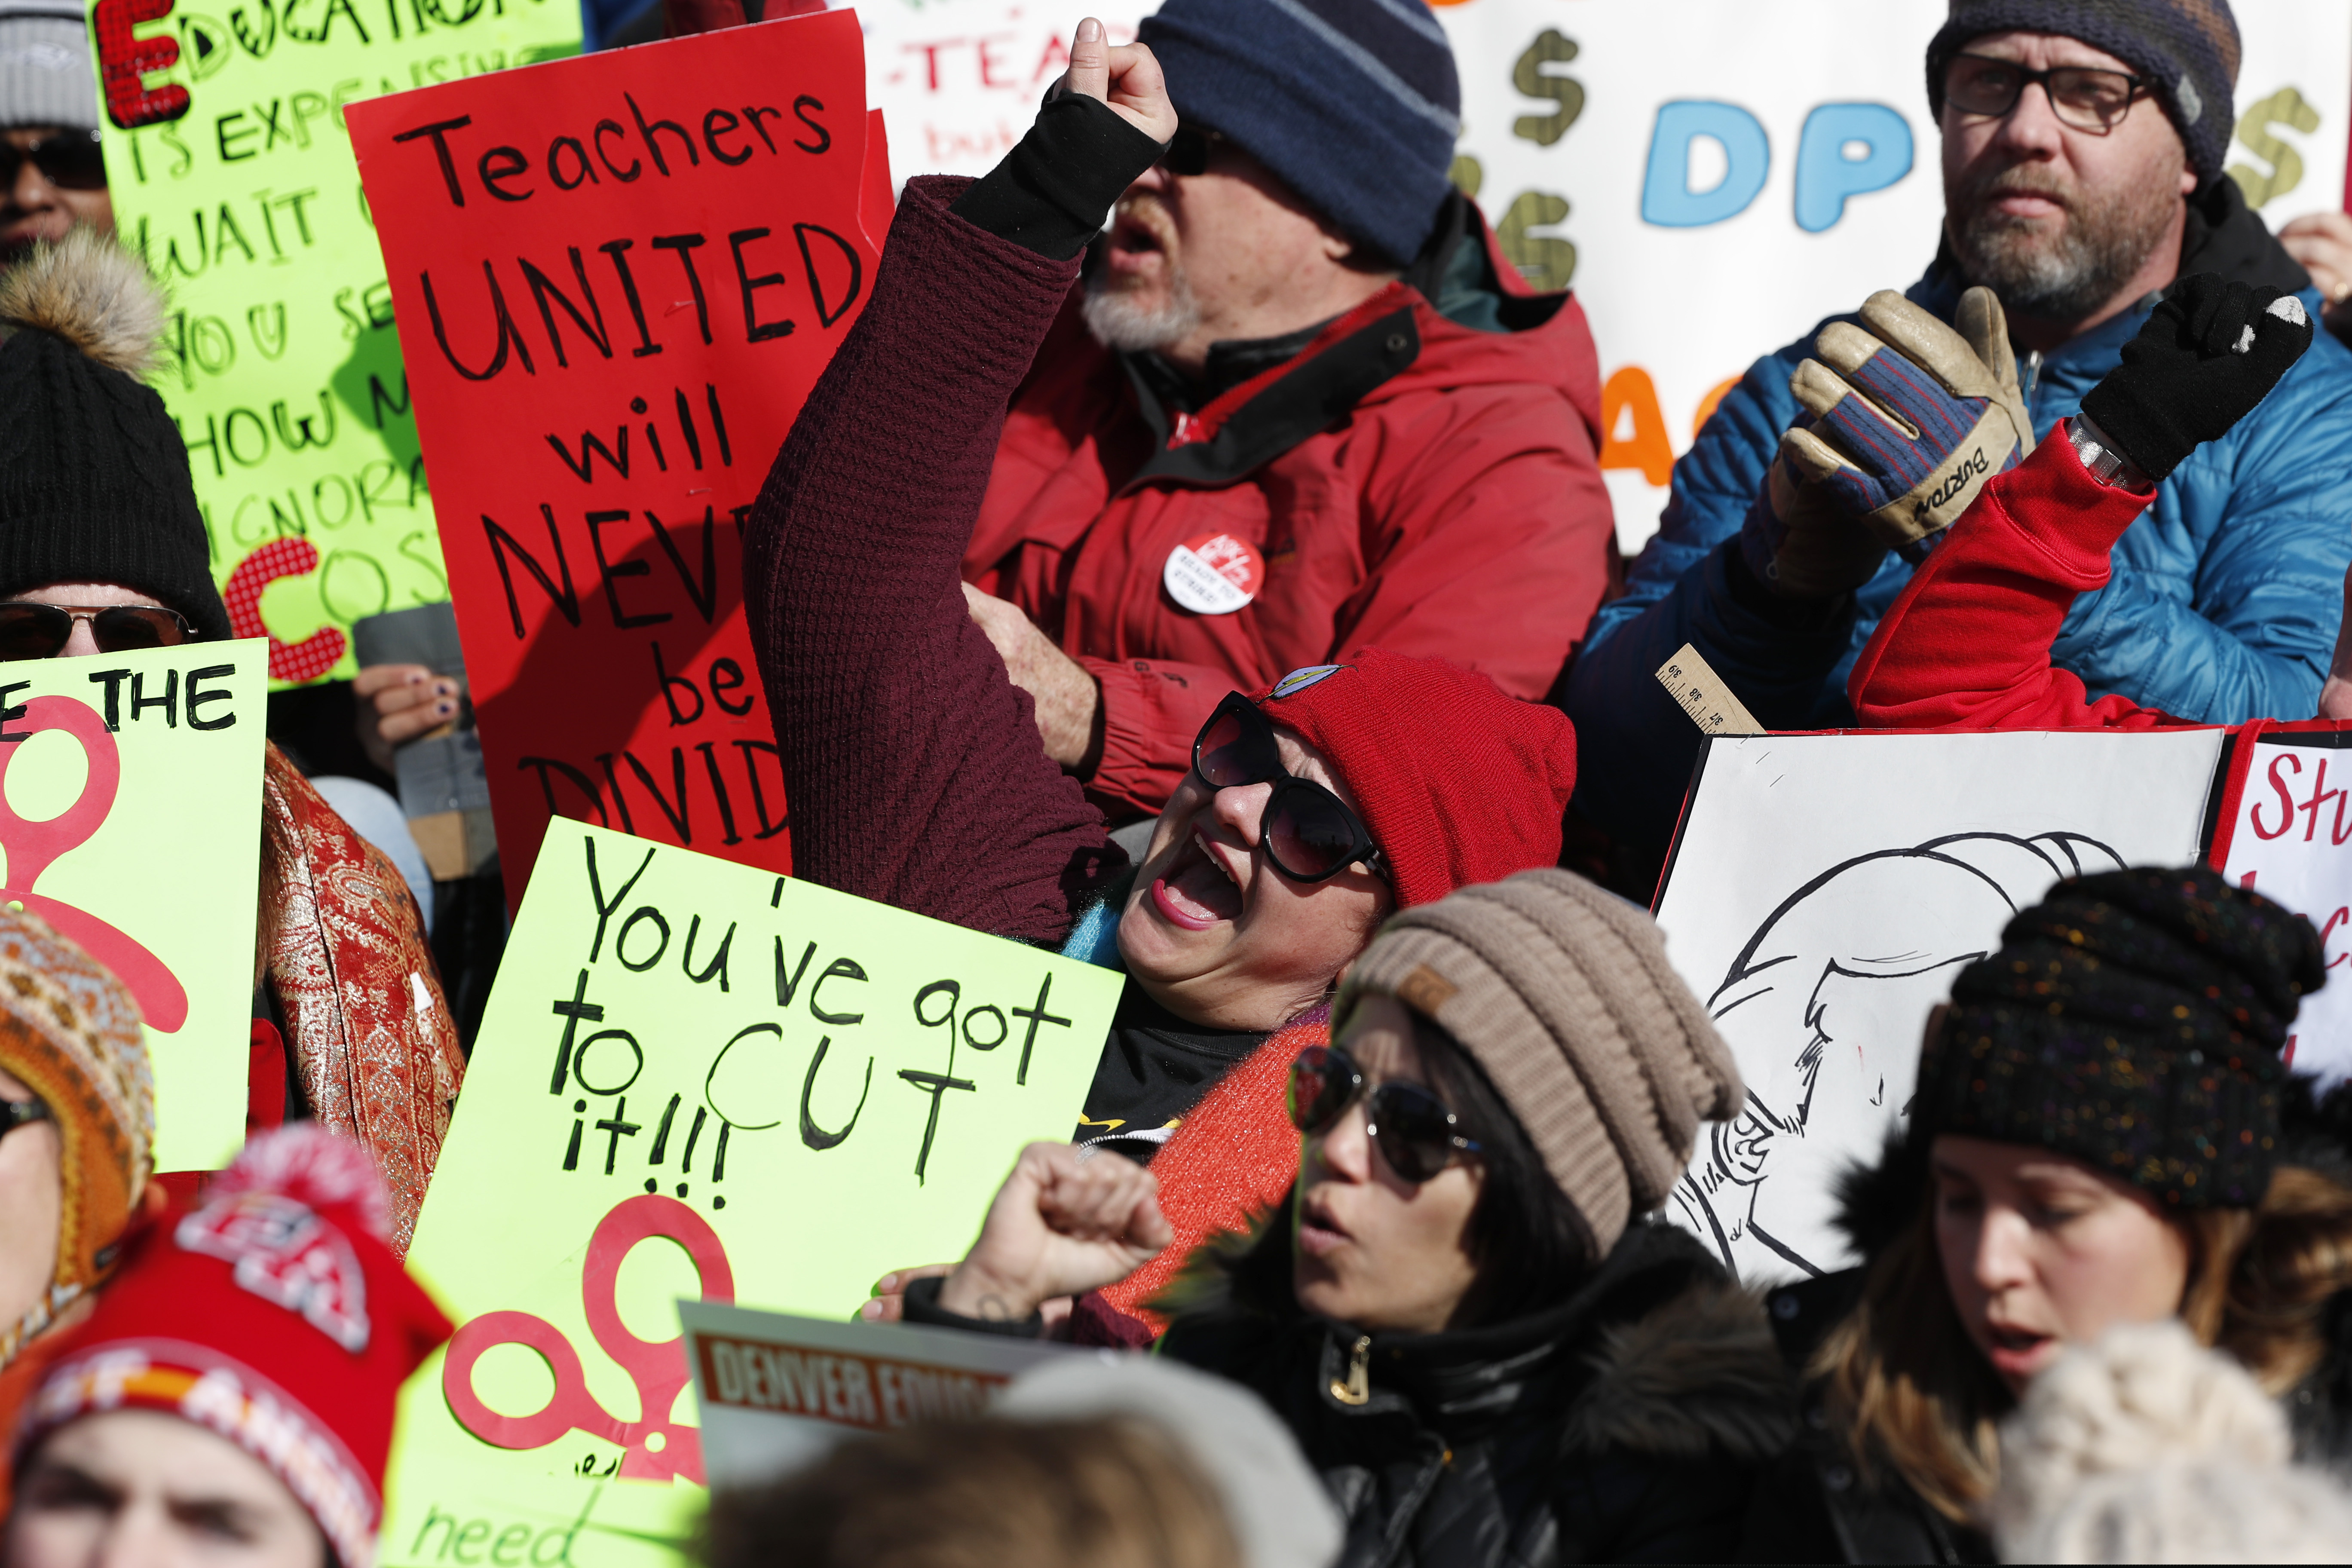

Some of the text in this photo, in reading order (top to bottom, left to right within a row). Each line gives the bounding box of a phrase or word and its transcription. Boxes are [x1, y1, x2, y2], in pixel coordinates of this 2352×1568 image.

[393, 91, 830, 207] Teachers
[137, 185, 317, 279] WAIT
[420, 222, 862, 381] UNITED
[174, 388, 340, 476] HOW
[543, 383, 732, 484] will
[1914, 446, 1989, 521] BURTON
[481, 502, 755, 640] NEV
[88, 664, 236, 733] THE
[650, 640, 755, 727] be
[1689, 688, 1703, 702] 38
[1709, 712, 1724, 726] 37
[585, 835, 1072, 1086] You've got
[549, 968, 977, 1188] to CUT
[562, 1093, 726, 1210] it!!!
[710, 1338, 880, 1428] DENVER
[408, 1482, 603, 1568] need
